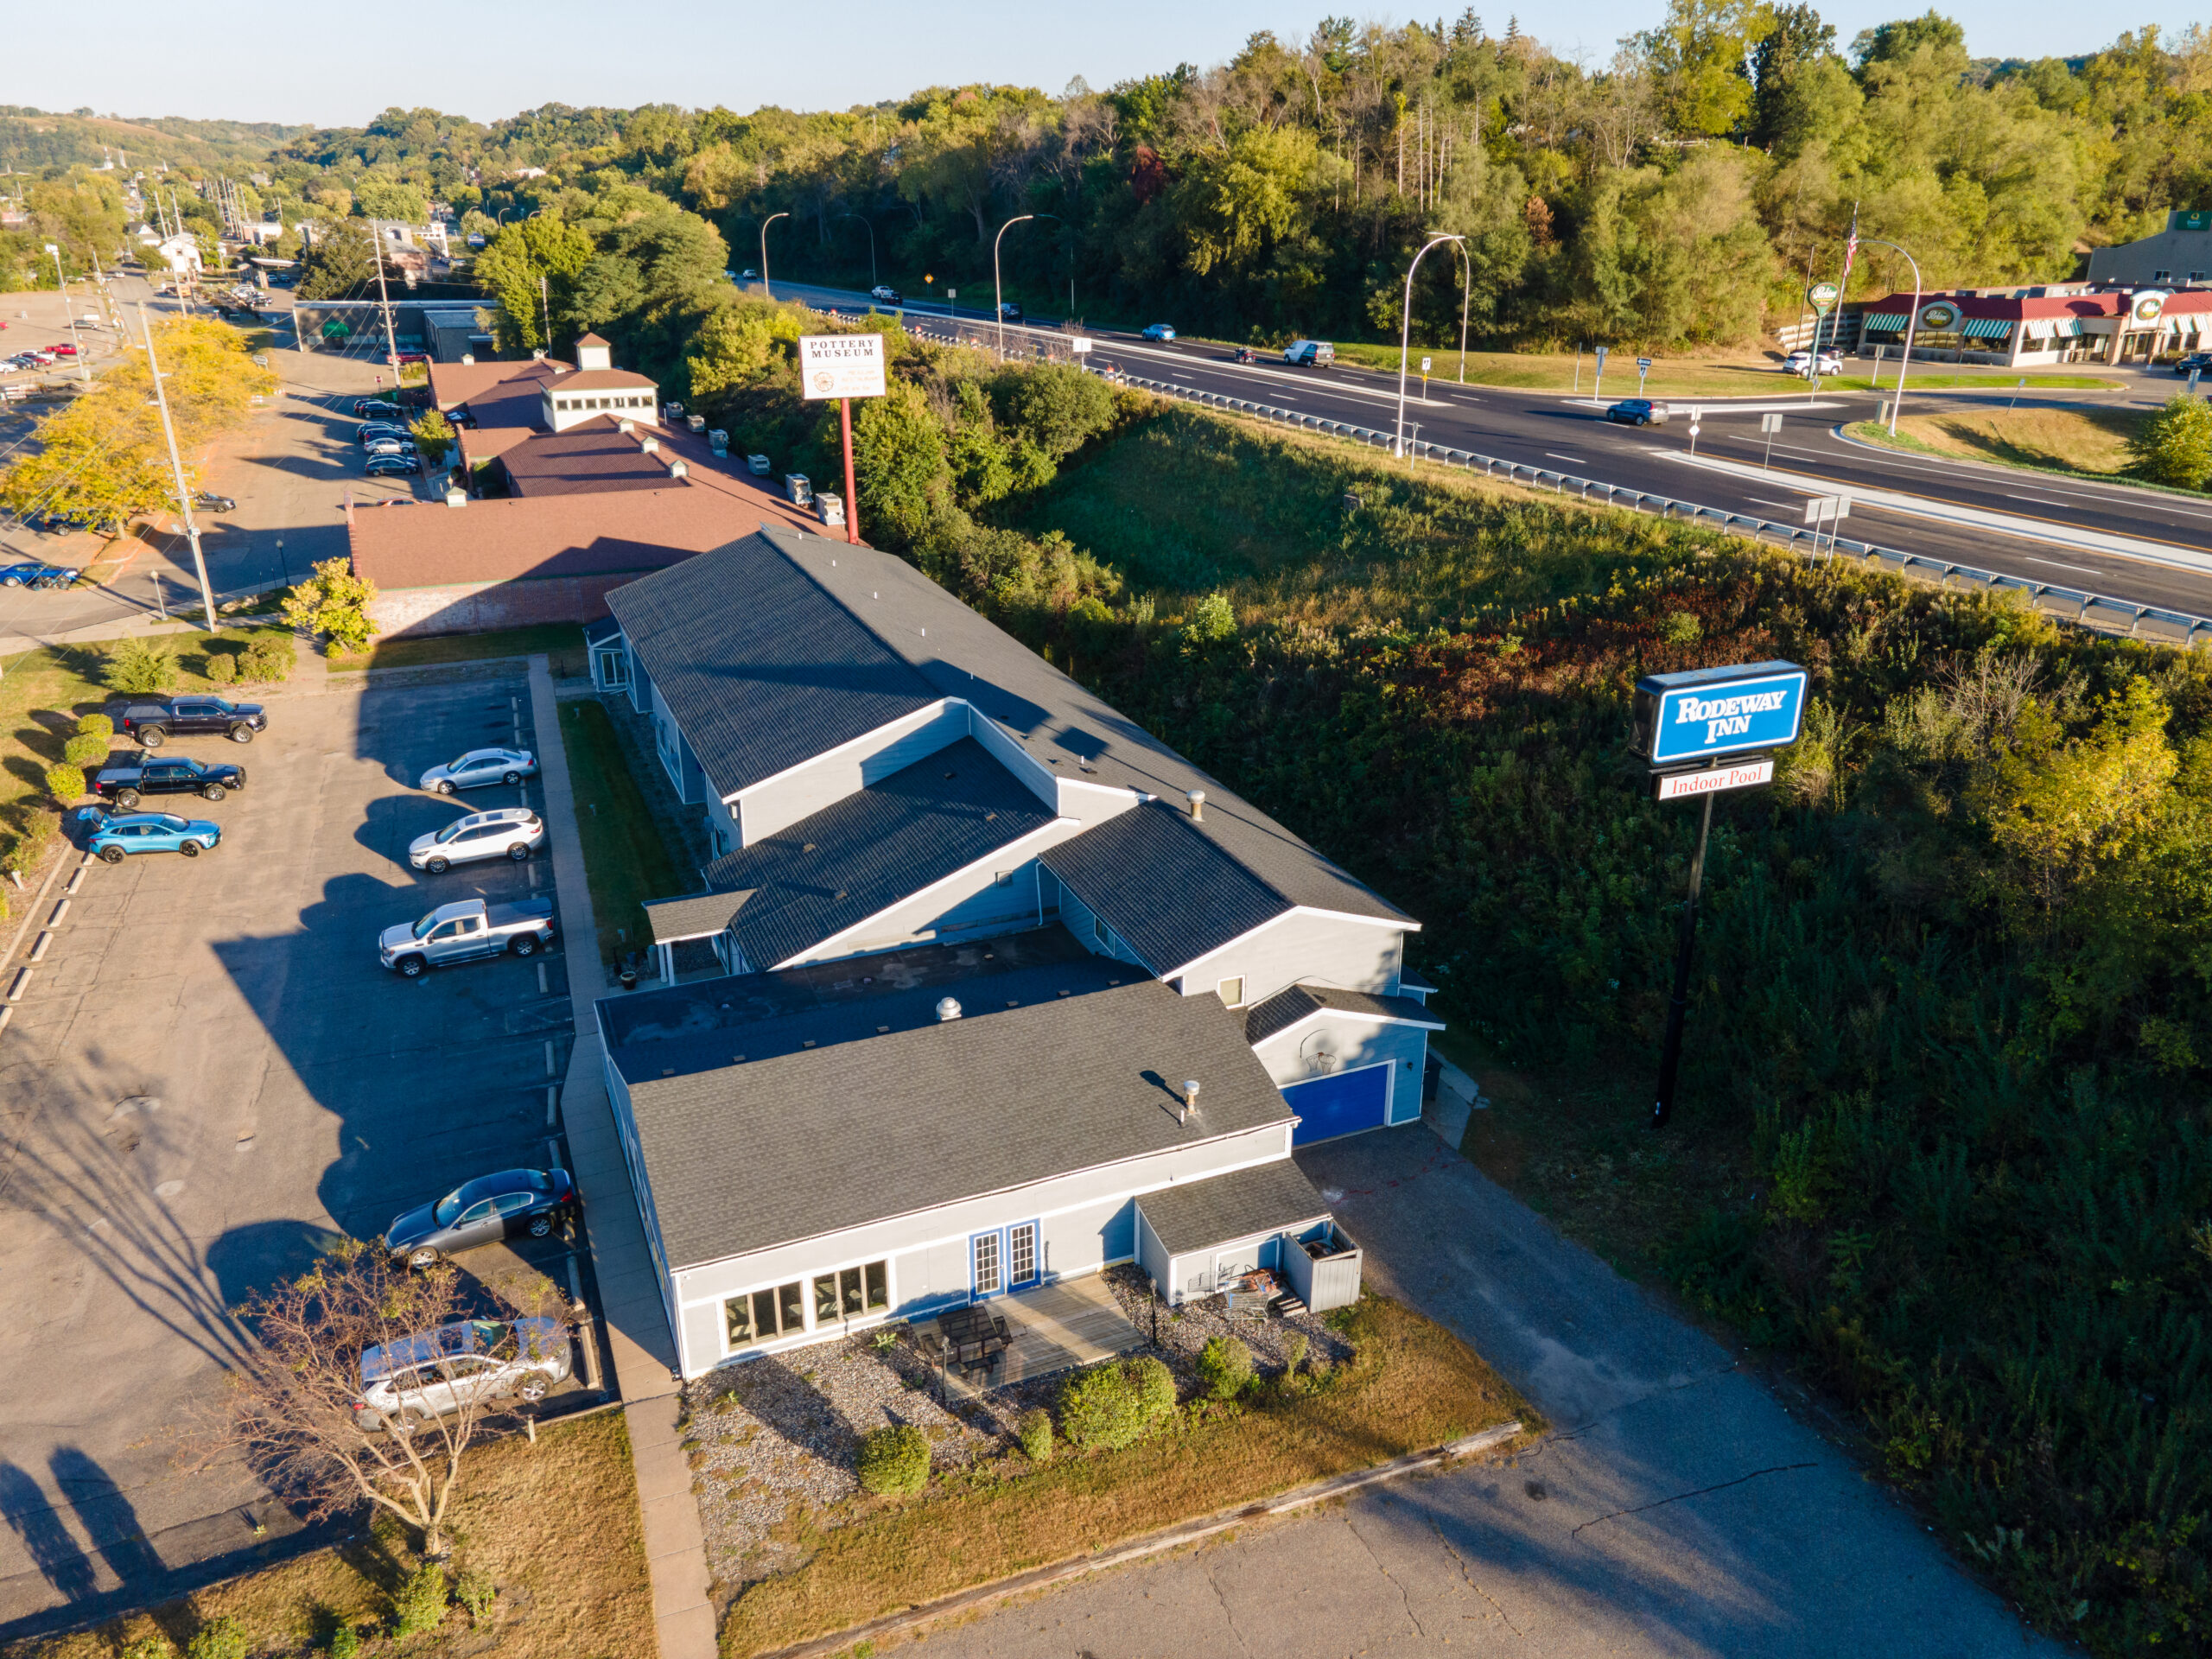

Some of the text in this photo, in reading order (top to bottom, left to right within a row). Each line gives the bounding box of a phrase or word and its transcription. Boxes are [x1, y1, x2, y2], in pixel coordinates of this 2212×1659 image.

[810, 340, 874, 349] POTTERY
[812, 348, 874, 358] MUSEUM
[1675, 690, 1787, 724] RODEWAY
[1705, 715, 1752, 744] INN
[1672, 766, 1763, 794] Indoor Pool
